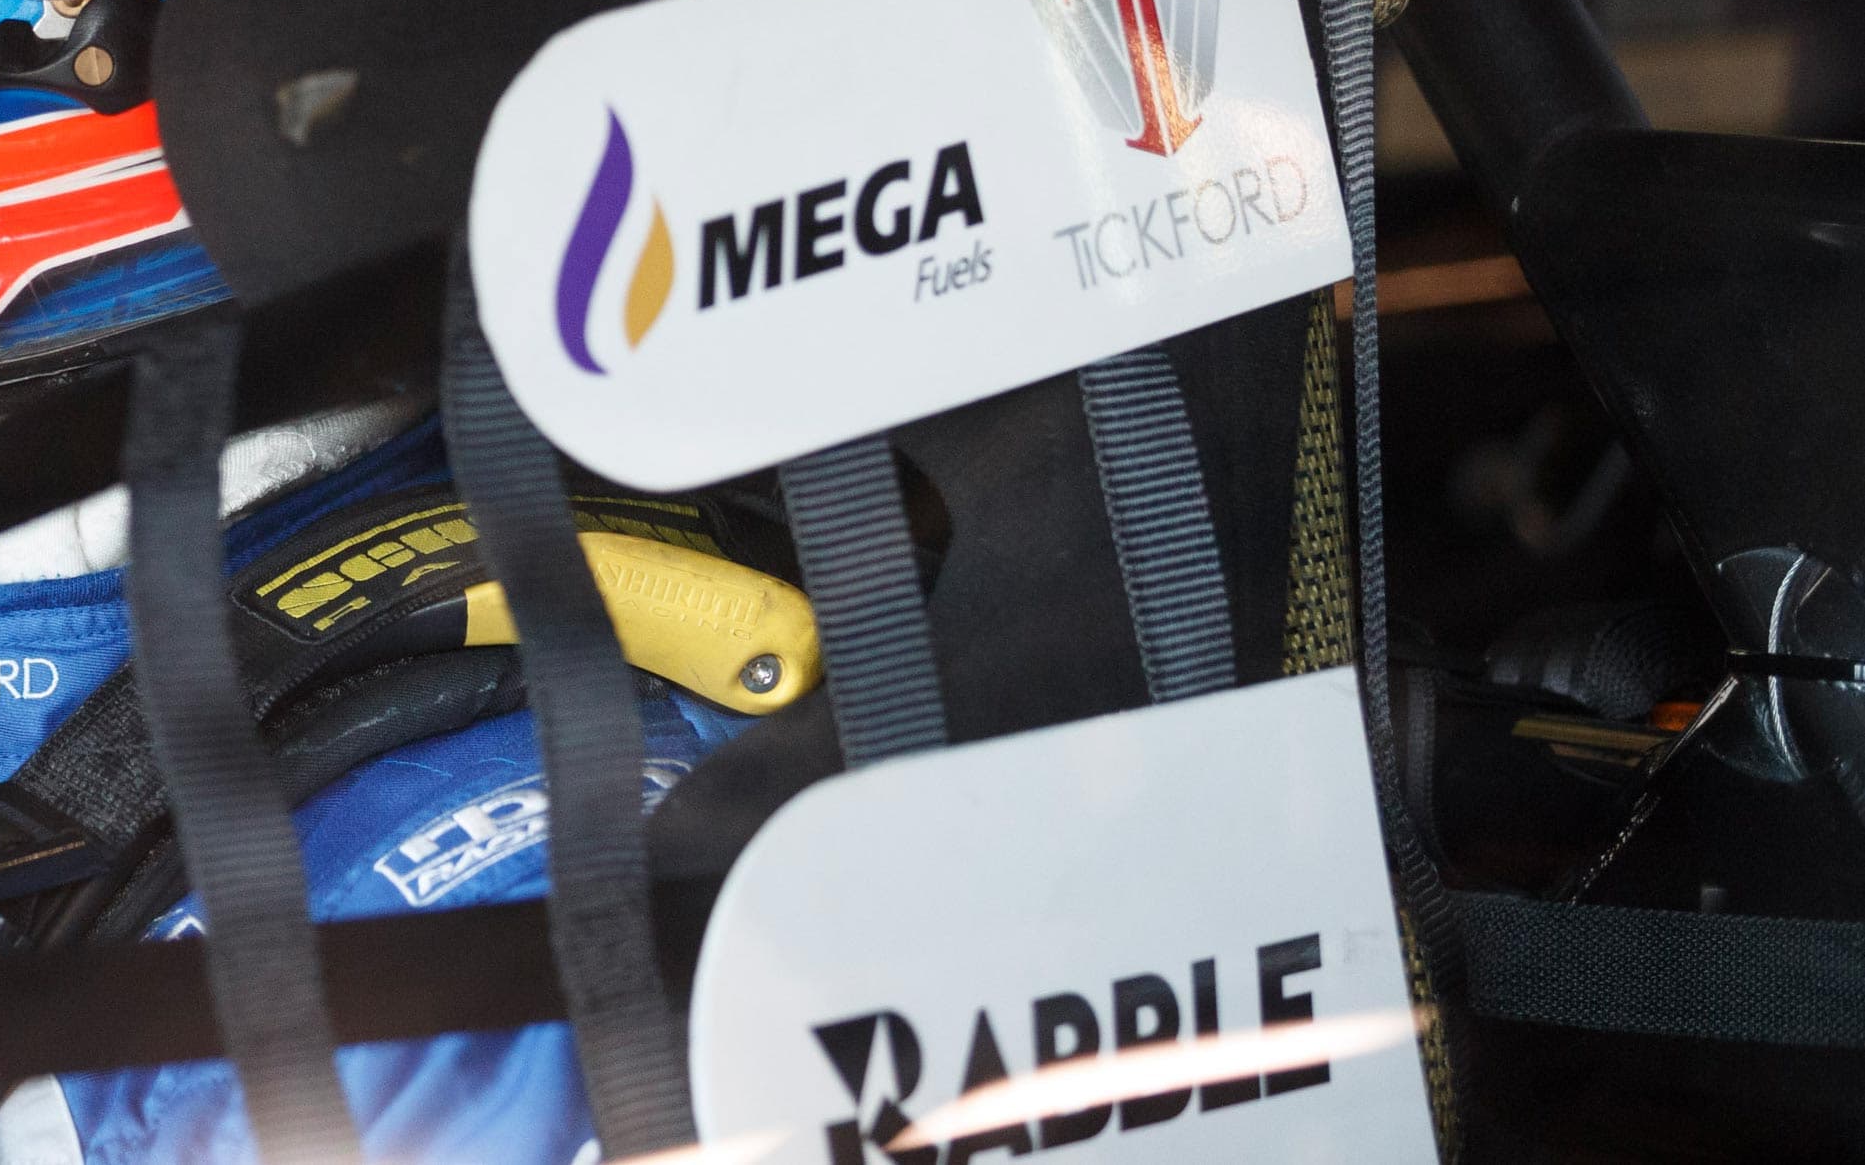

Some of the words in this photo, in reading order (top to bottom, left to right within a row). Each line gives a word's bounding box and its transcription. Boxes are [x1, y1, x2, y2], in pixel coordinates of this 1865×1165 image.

[697, 139, 985, 312] MEGA
[913, 239, 993, 304] Fuels
[1053, 155, 1308, 290] TICKFORD
